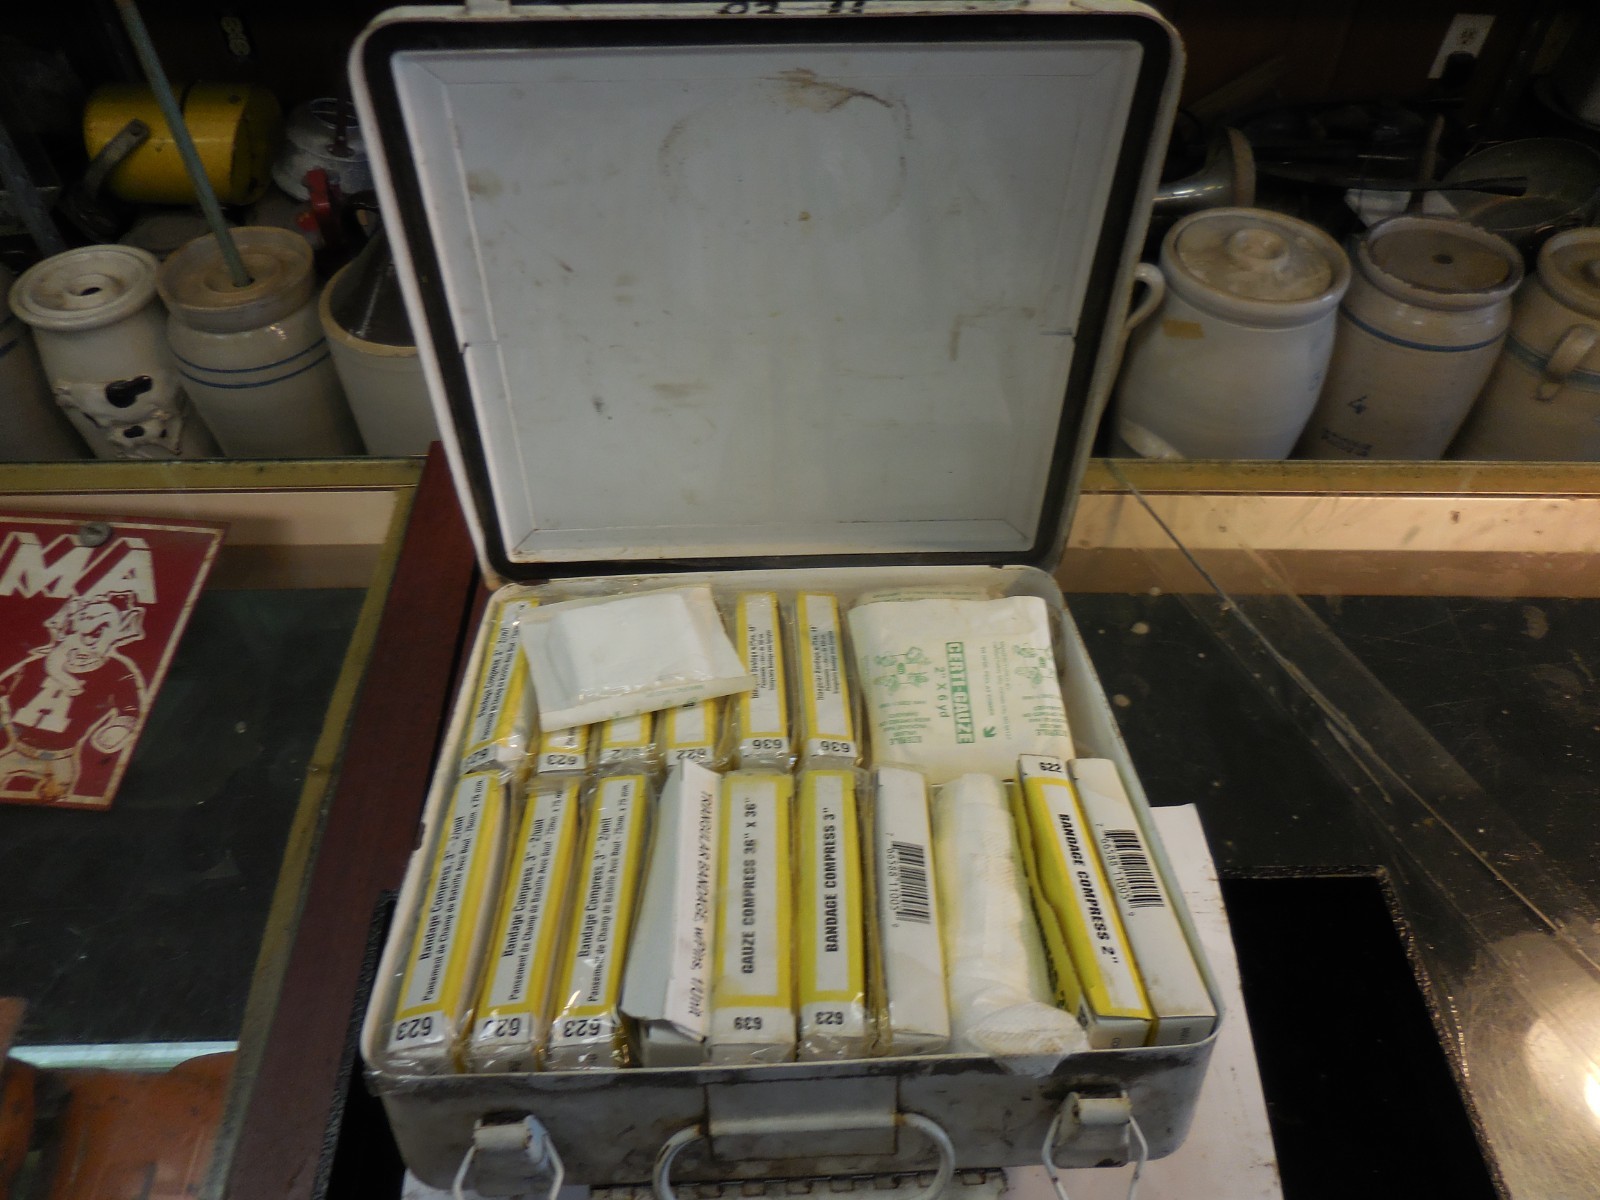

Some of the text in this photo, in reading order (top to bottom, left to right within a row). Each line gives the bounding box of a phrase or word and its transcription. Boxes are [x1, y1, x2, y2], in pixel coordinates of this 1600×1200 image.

[935, 705, 950, 717] yd
[752, 739, 782, 749] 636
[820, 741, 850, 752] 636
[547, 754, 578, 766] 623
[1039, 761, 1062, 773] 622
[745, 797, 757, 817] 36"
[597, 818, 611, 840] 2/unit
[593, 849, 605, 859] 3"
[744, 833, 756, 854] 36"
[1100, 838, 1119, 867] 66588
[886, 849, 897, 877] 66588
[823, 807, 838, 952] BANDAGE COMPRESS 3"
[1058, 814, 1118, 963] BANDAGE COMPRESS 2"
[742, 859, 756, 925] COMPRESS
[446, 903, 455, 911] de
[528, 904, 539, 912] de
[601, 905, 611, 913] de
[440, 914, 455, 941] Champ
[502, 913, 524, 957] Bandage
[523, 914, 539, 940] Champ
[578, 914, 597, 957] Bandage
[598, 916, 613, 941] Champ
[419, 916, 441, 960] Bandage
[520, 943, 531, 952] de
[434, 945, 445, 953] de
[596, 945, 606, 954] de
[741, 932, 755, 974] GAUZE
[422, 956, 444, 1000] Pansement
[508, 954, 529, 999] Pansement
[396, 1016, 433, 1041] 623
[563, 1019, 601, 1036] 623
[734, 1017, 762, 1030] 639
[816, 1011, 843, 1025] 623
